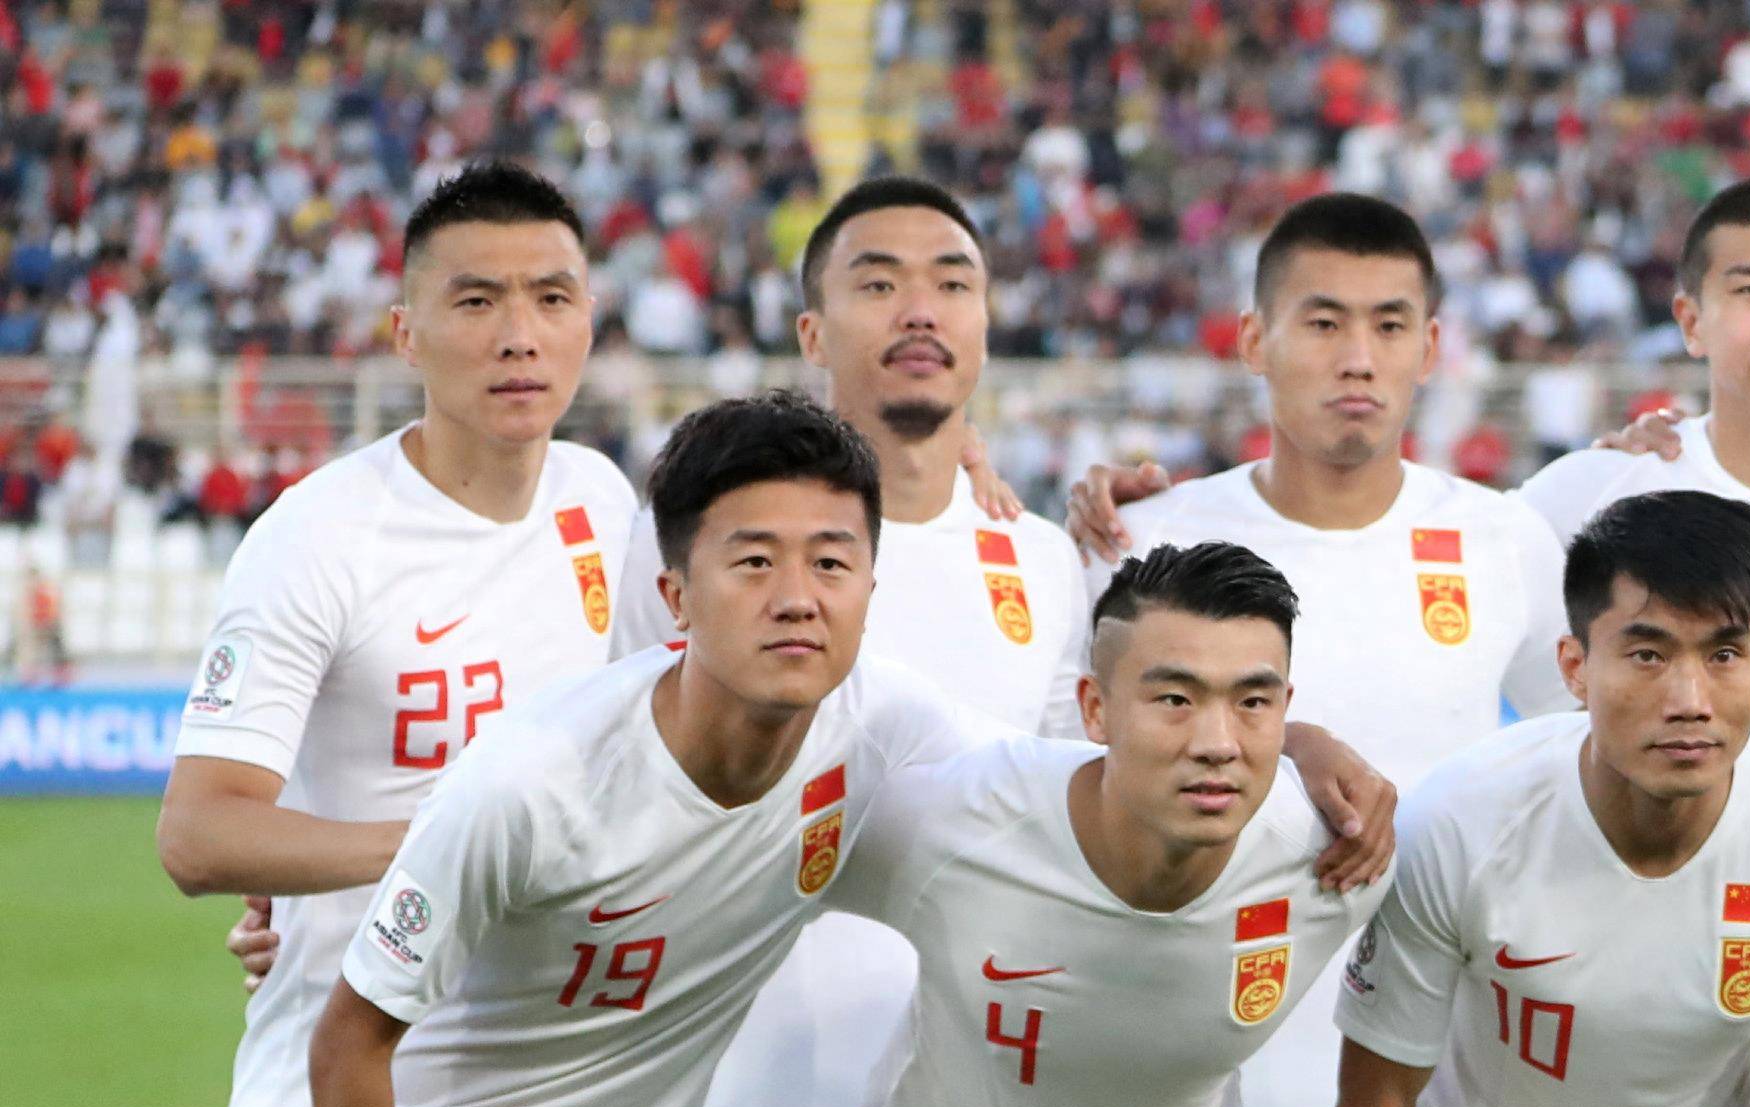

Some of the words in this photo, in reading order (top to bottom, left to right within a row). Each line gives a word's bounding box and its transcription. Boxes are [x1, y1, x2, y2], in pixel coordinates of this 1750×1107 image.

[393, 660, 504, 770] 22
[557, 936, 666, 1011] 19
[1239, 950, 1287, 974] CFA
[988, 1000, 1042, 1085] 4
[1490, 979, 1575, 1082] 10
